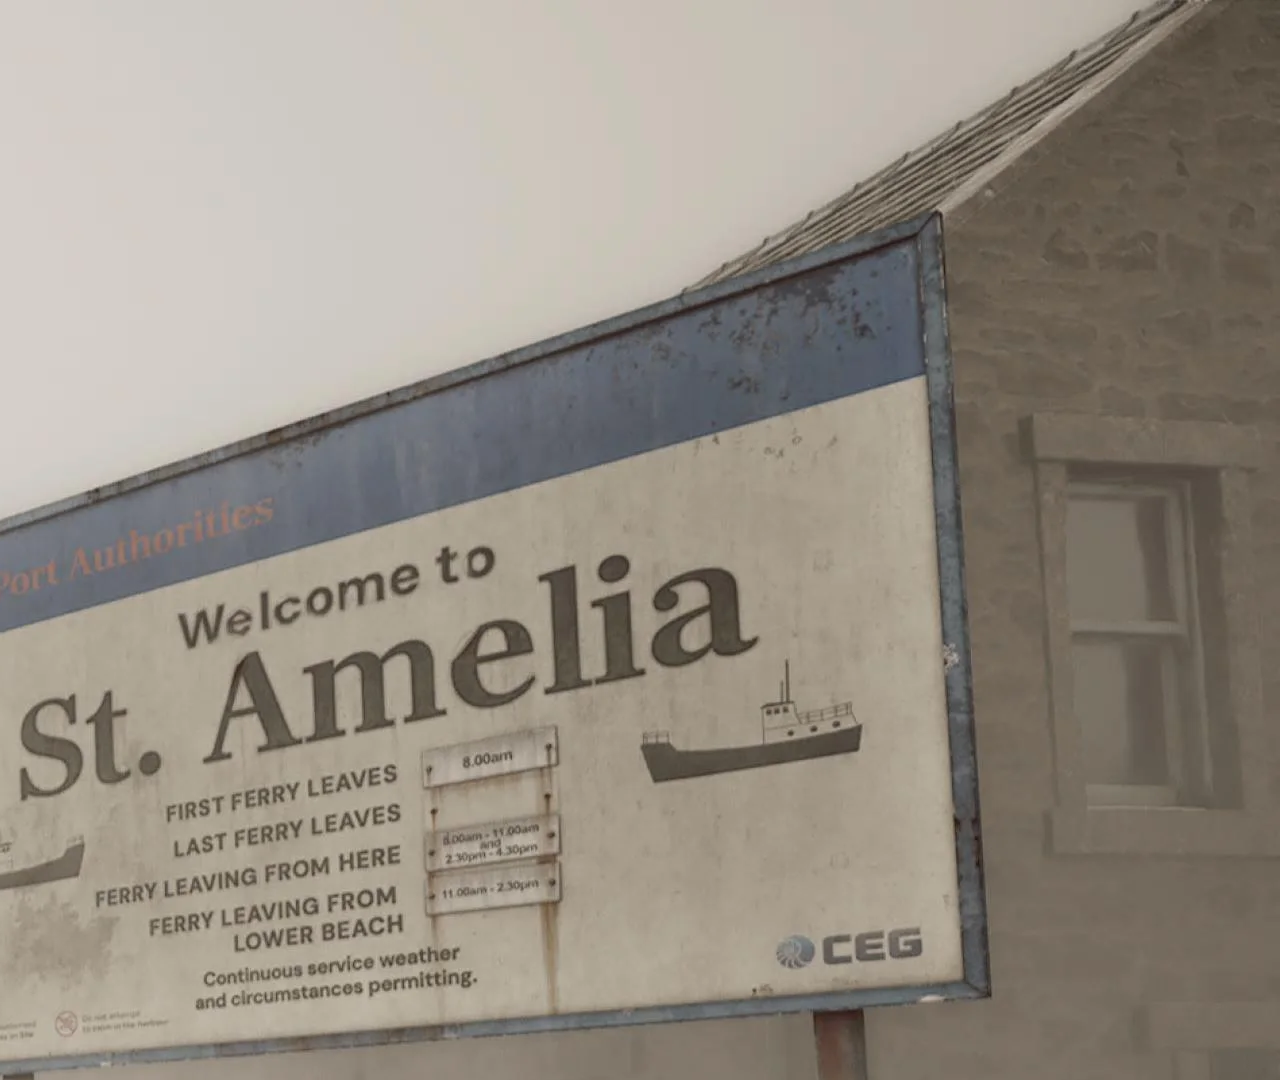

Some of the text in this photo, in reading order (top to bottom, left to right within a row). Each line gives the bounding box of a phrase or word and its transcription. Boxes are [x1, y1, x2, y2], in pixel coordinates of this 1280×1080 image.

[69, 497, 275, 578] Authorities
[178, 545, 495, 649] Welcome to
[19, 555, 758, 801] St. Amelia
[462, 751, 513, 769] 8.00am
[166, 763, 398, 823] FIRST FERRY LEAVES
[173, 803, 401, 859] LAST FERRY LEAVES
[480, 839, 501, 849] and
[493, 823, 540, 837] 11.00am
[445, 851, 486, 864] 2.30pm
[496, 843, 538, 857] 4.30pm
[95, 846, 401, 909] FERRY LEAVING FROM HERE
[442, 886, 487, 899] 11.00am
[497, 880, 540, 893] 2.30pm
[149, 886, 397, 937] FERRY LEAVING FROM
[234, 914, 403, 952] LOWER BEACH
[822, 927, 923, 966] CEG
[203, 945, 460, 988] Continuous service weather
[195, 970, 478, 1011] and circumstances permitting.
